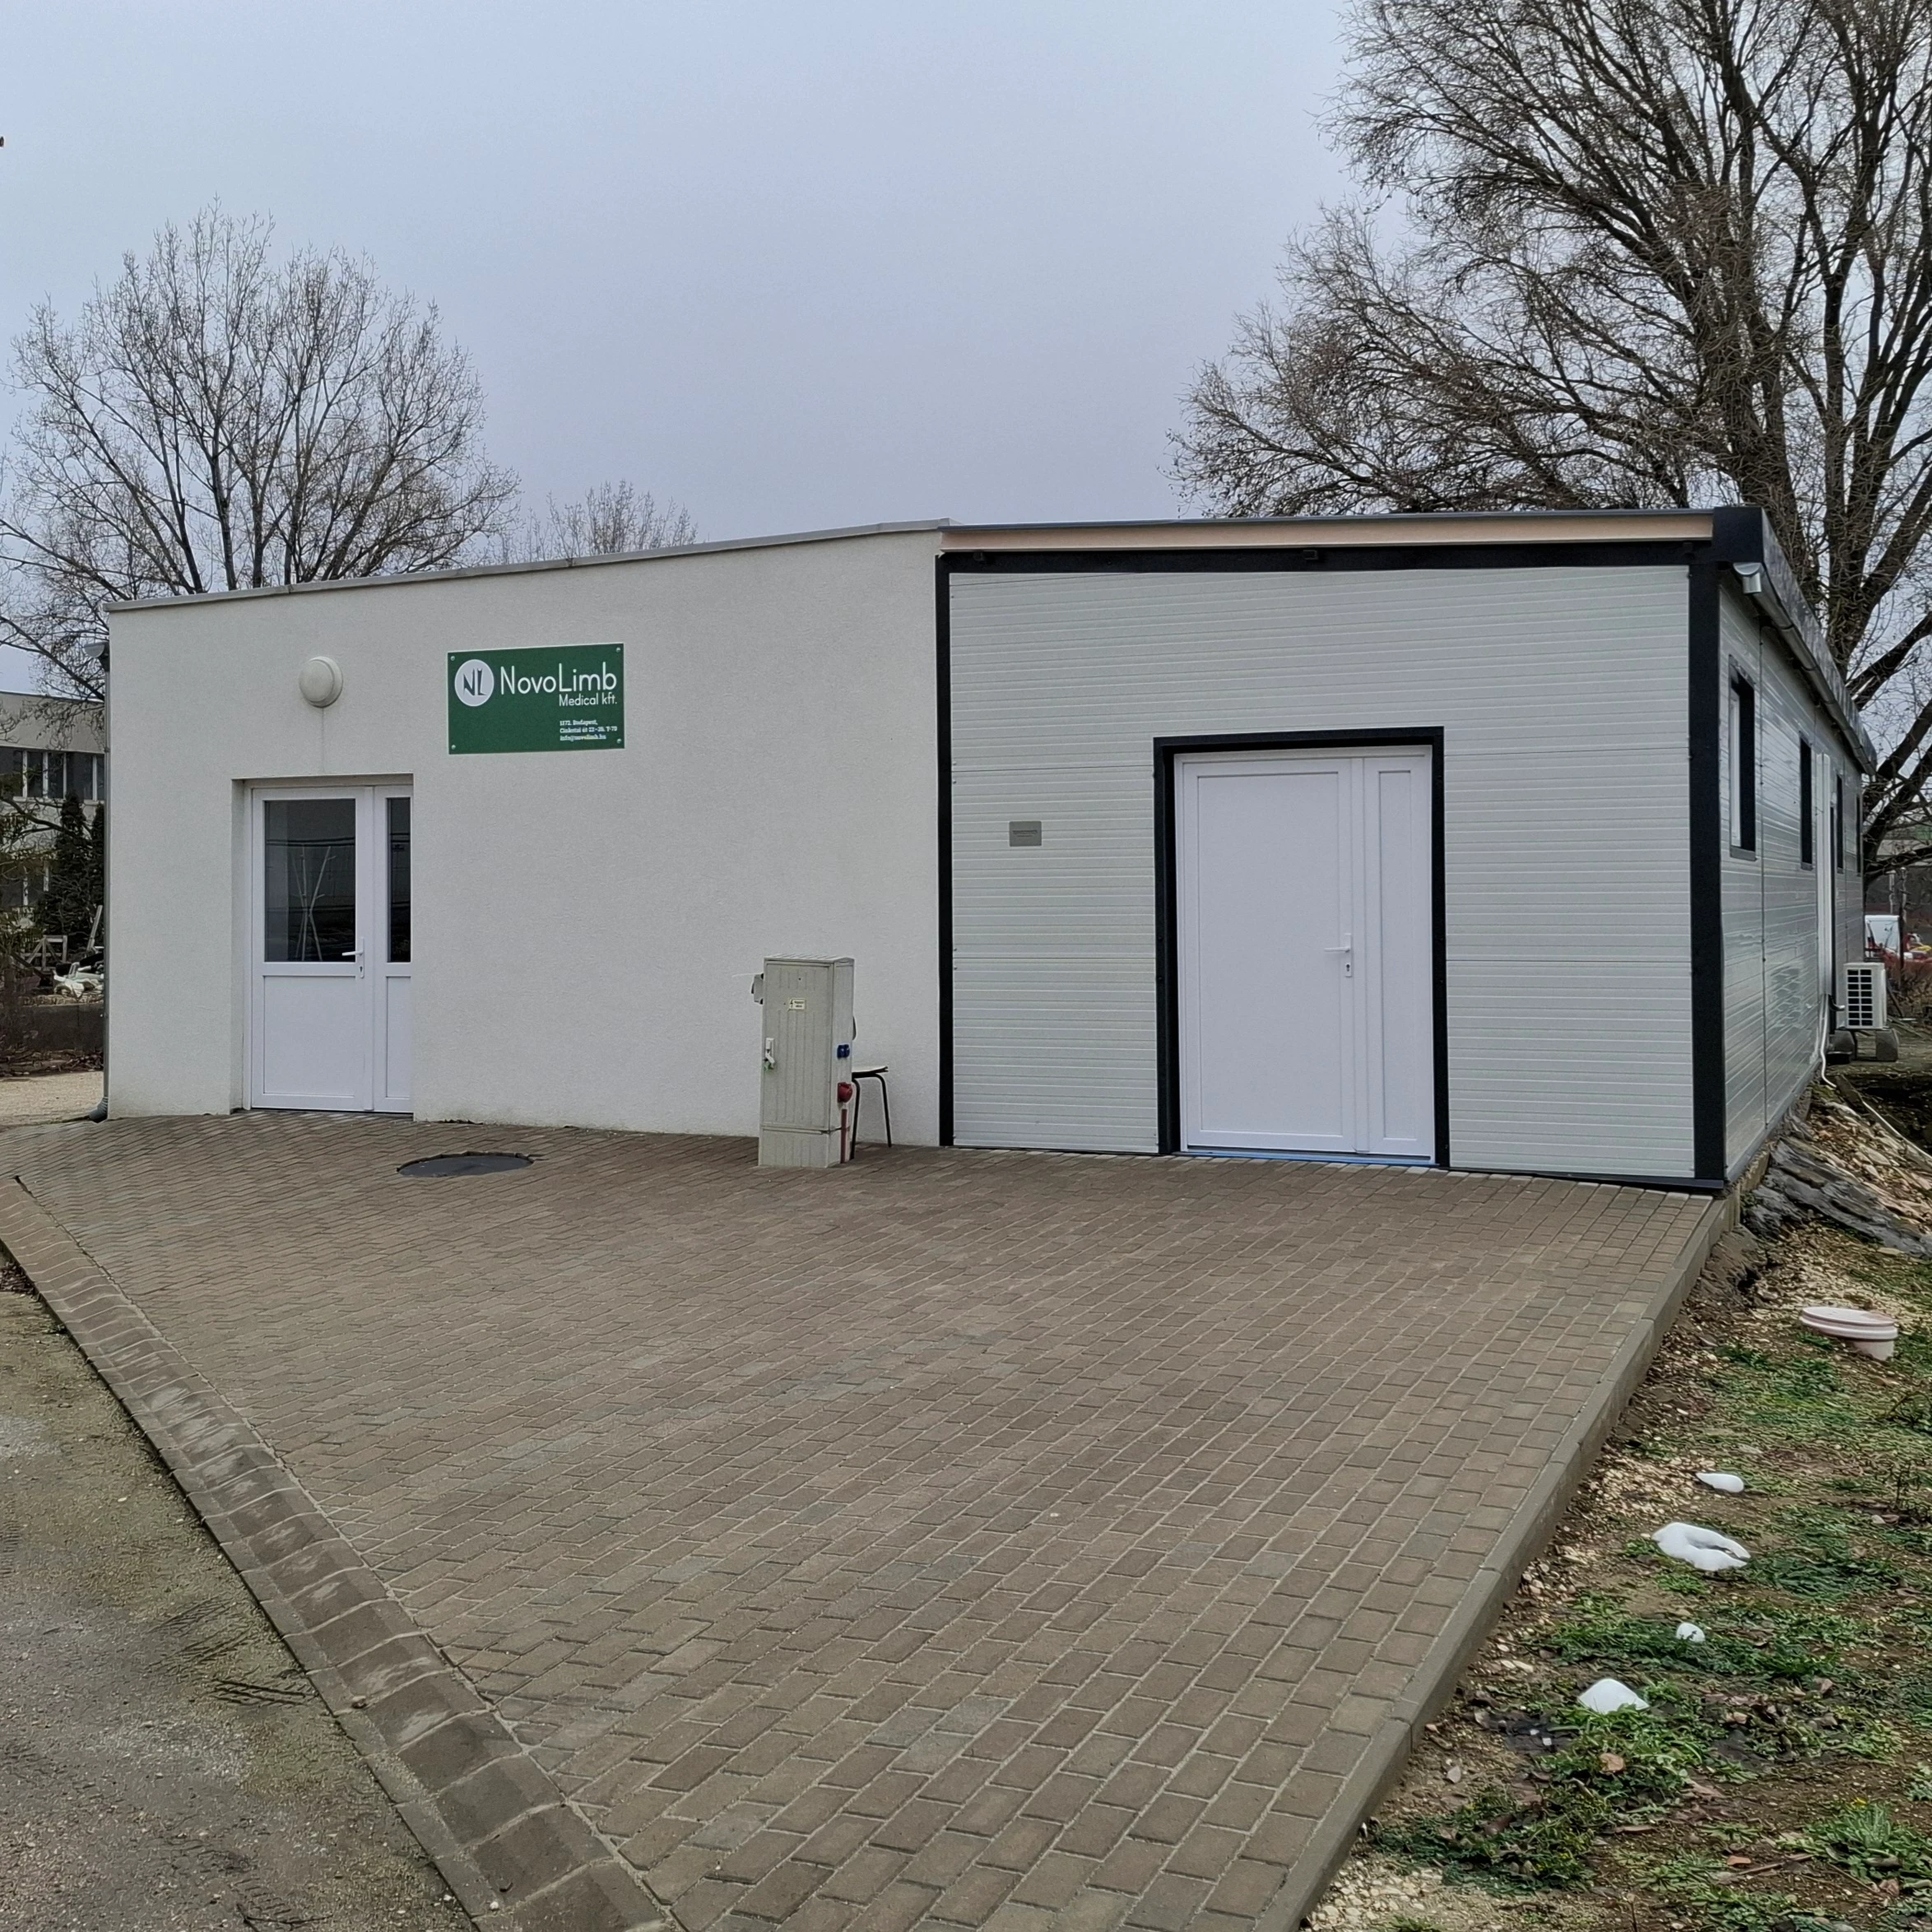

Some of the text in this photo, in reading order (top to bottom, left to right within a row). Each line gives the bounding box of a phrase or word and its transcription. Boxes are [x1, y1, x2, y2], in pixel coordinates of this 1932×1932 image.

[500, 661, 617, 695] NovoLimb
[559, 691, 618, 707] Medical kft.
